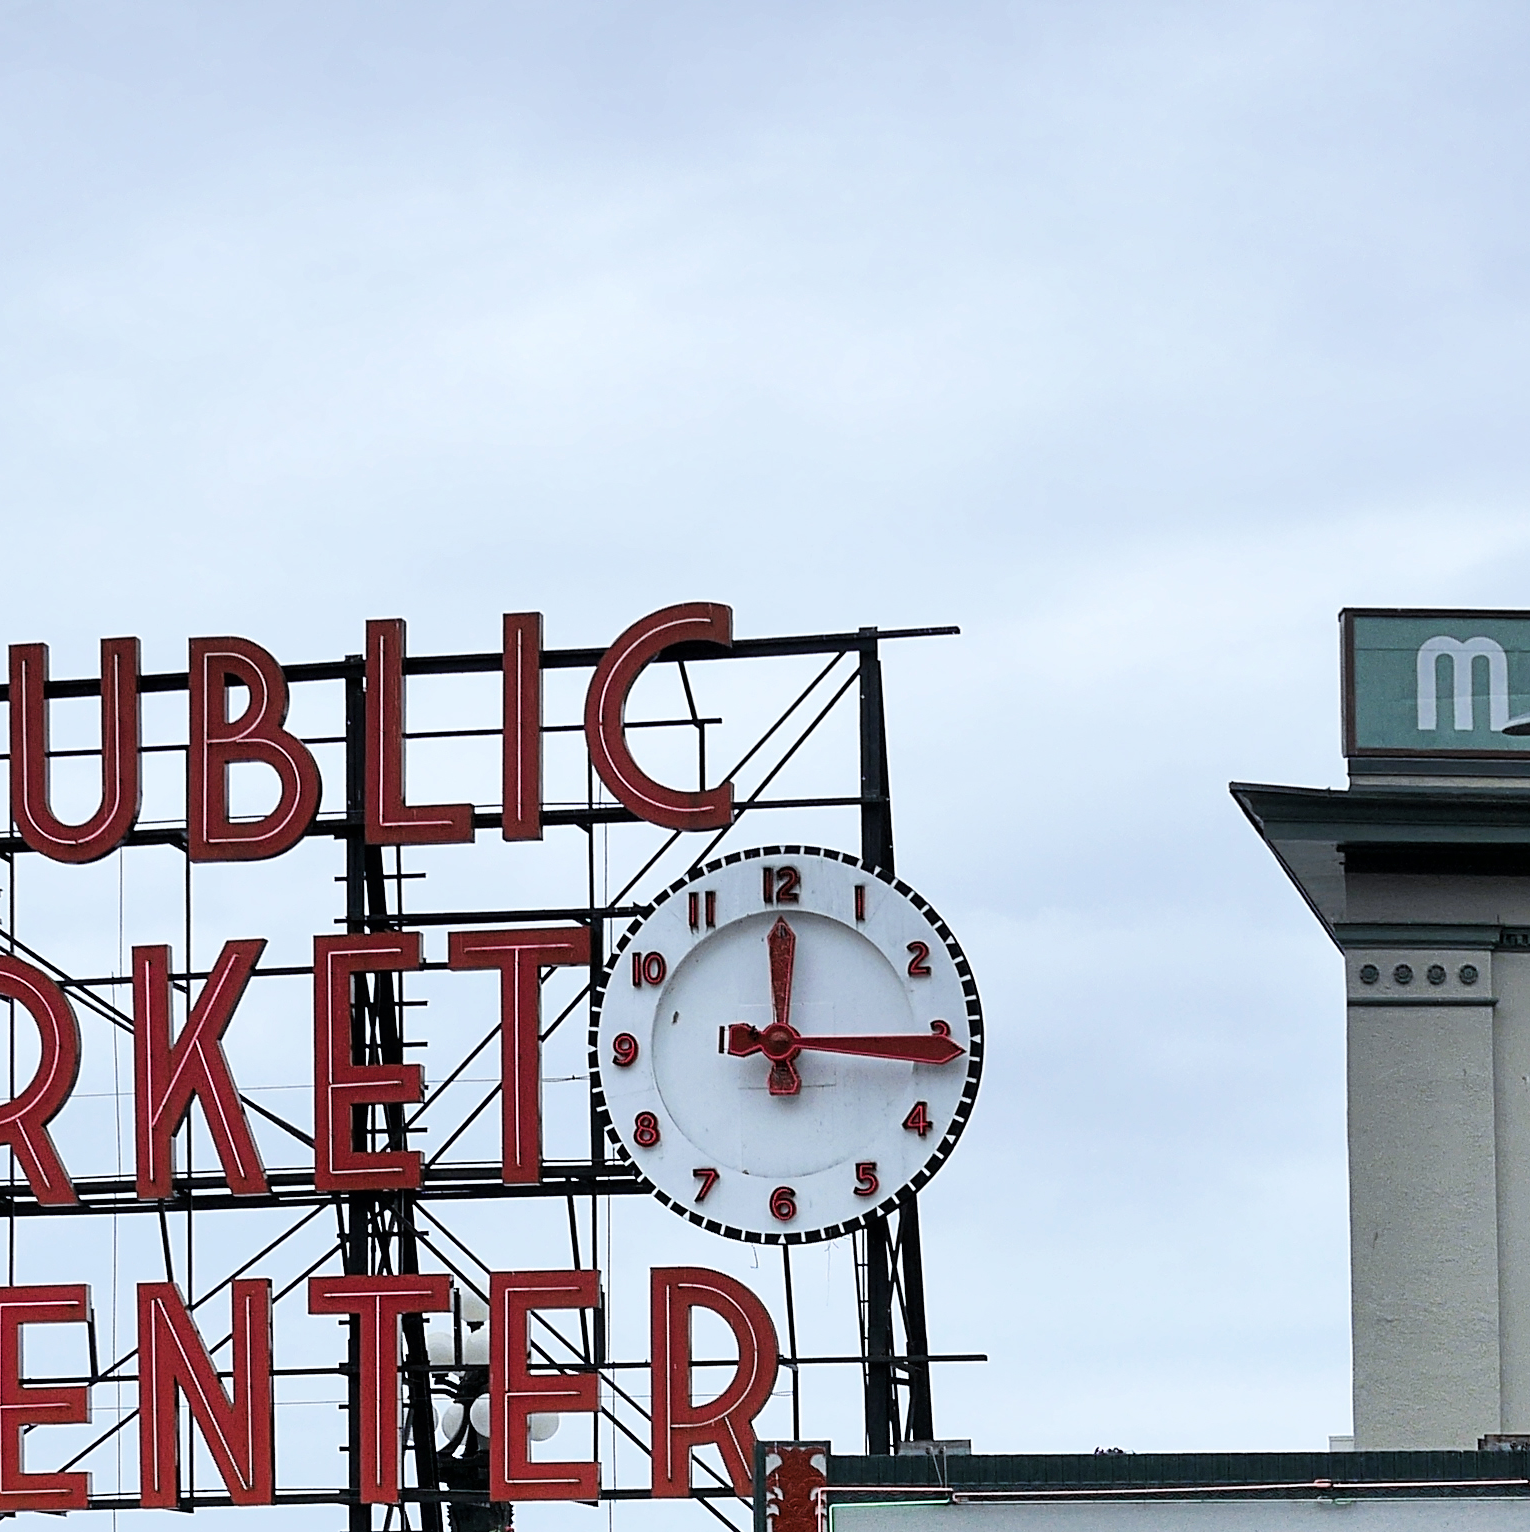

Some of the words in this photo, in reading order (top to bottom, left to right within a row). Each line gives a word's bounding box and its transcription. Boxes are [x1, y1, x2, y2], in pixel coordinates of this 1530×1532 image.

[762, 866, 801, 903] 12
[688, 890, 717, 931] 11
[854, 885, 866, 922] 1
[631, 951, 667, 988] 10
[906, 941, 932, 978] 2
[612, 1032, 639, 1068] 9
[633, 1111, 660, 1148] 8
[901, 1101, 933, 1138] 4
[692, 1167, 720, 1203] 7
[853, 1162, 880, 1198] 5
[768, 1186, 797, 1222] 6
